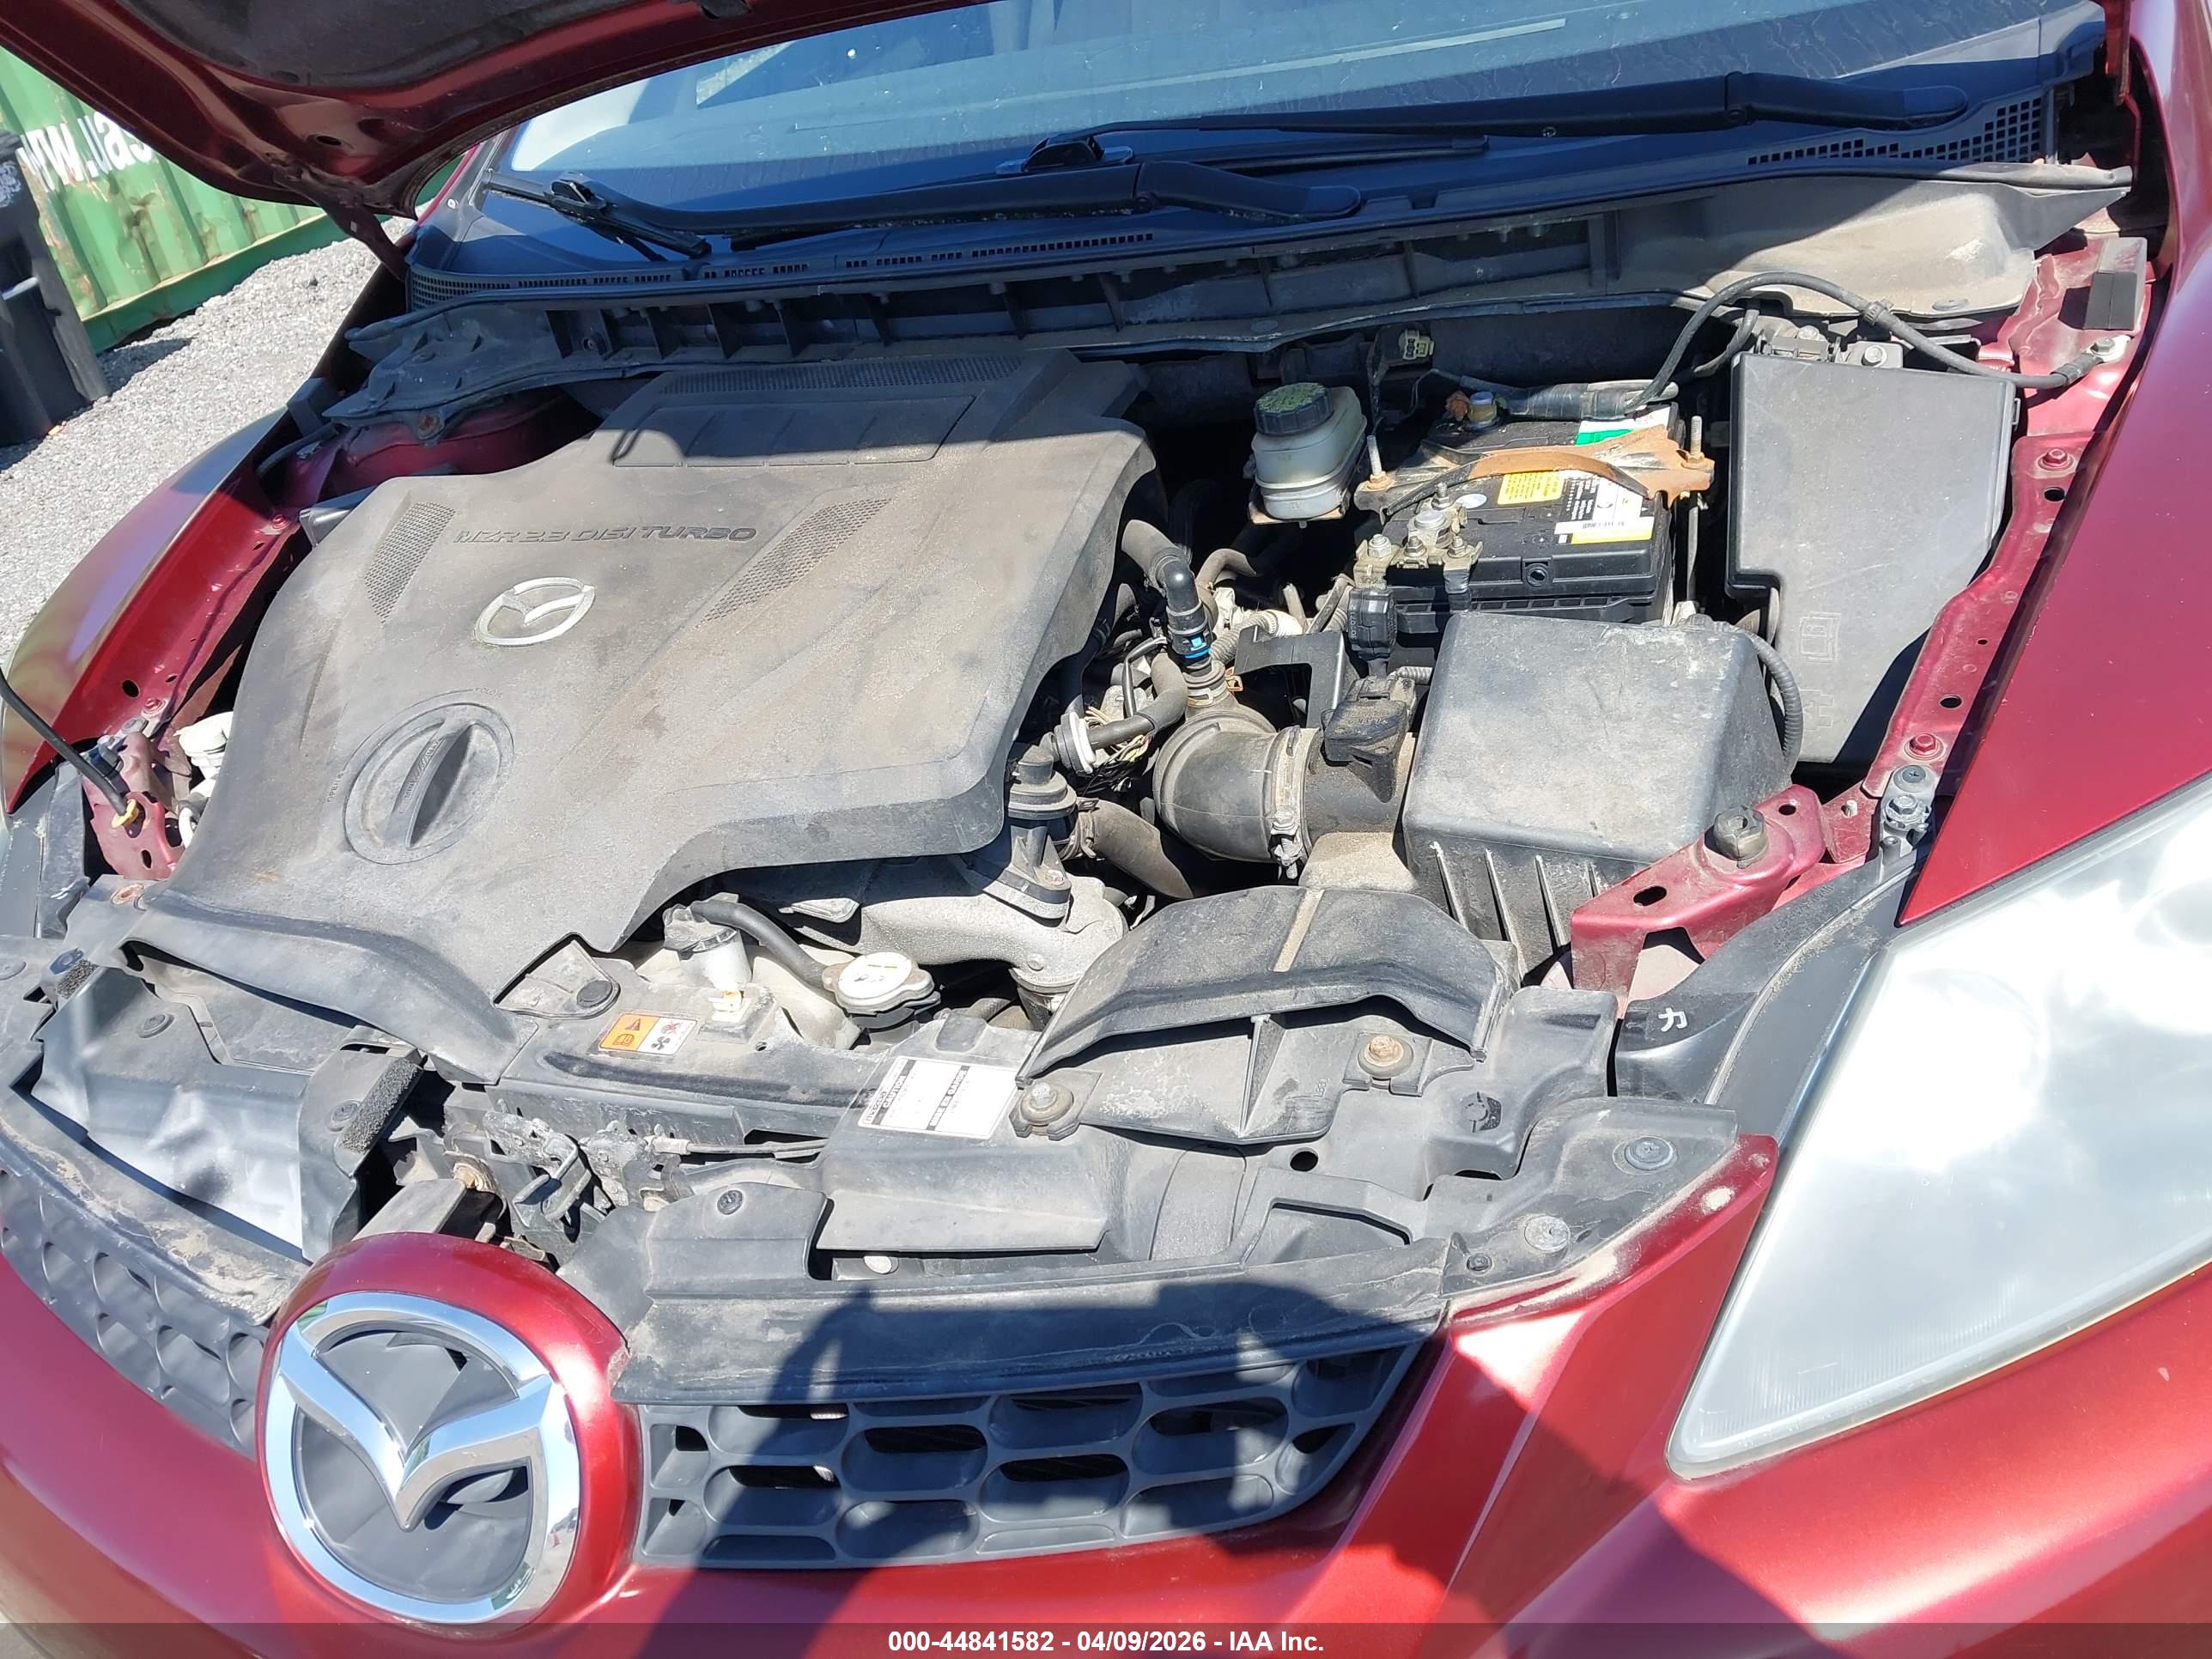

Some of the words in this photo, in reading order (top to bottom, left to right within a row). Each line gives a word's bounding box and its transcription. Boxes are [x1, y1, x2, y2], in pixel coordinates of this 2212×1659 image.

[570, 526, 638, 542] DISI
[641, 525, 758, 542] TURBO
[883, 1075, 906, 1109] CAUTION
